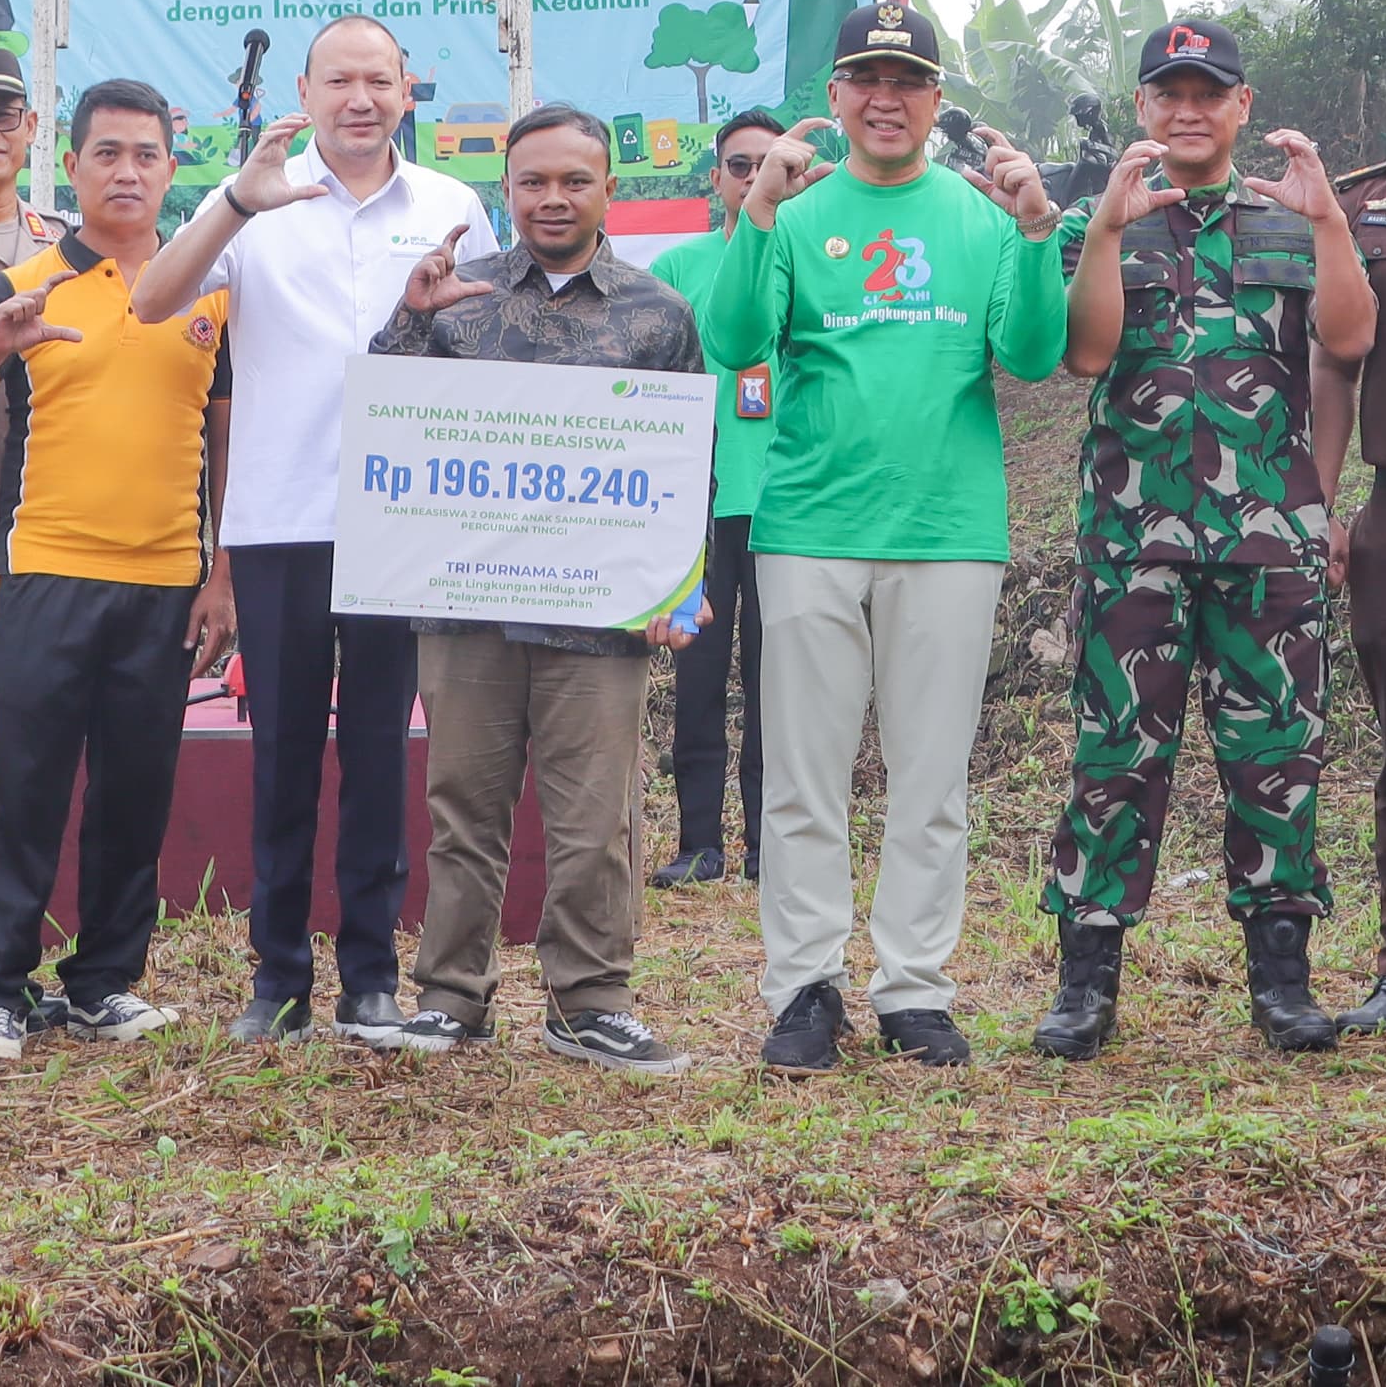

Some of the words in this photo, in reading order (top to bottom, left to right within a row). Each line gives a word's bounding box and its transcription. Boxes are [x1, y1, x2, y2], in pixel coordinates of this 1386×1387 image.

[166, 0, 263, 26] dengan
[861, 233, 932, 292] 23
[823, 312, 858, 328] Dinas
[935, 305, 967, 327] Hidup
[642, 382, 669, 393] BPJS
[367, 403, 469, 423] SANTUNAN
[474, 409, 557, 428] JAMINAN
[562, 414, 685, 436] KECELAKAAN
[423, 427, 482, 444] KERJA
[485, 430, 525, 446] DAN
[530, 433, 627, 452] BEASISWA
[363, 454, 411, 501] Rp
[426, 457, 675, 514] 196.138.240,-
[384, 506, 409, 515] DAN
[411, 507, 468, 518] BEASISWA
[470, 509, 479, 518] 2
[480, 510, 520, 522] ORANG
[522, 513, 553, 523] ANAK
[555, 514, 598, 526] SAMPAI
[599, 517, 646, 529] DENGAN
[461, 522, 529, 534] PERGURUAN
[531, 525, 568, 536] TINGGI
[445, 561, 470, 575] TRI
[475, 563, 558, 580] PURNAMA
[562, 567, 599, 582] SARI
[429, 577, 463, 589] Dinas
[466, 579, 537, 595] Lingkungan
[539, 581, 576, 598] Hidup
[578, 584, 612, 597] UPTD
[446, 591, 508, 608] Pelayanan
[510, 594, 593, 610] Persampahan
